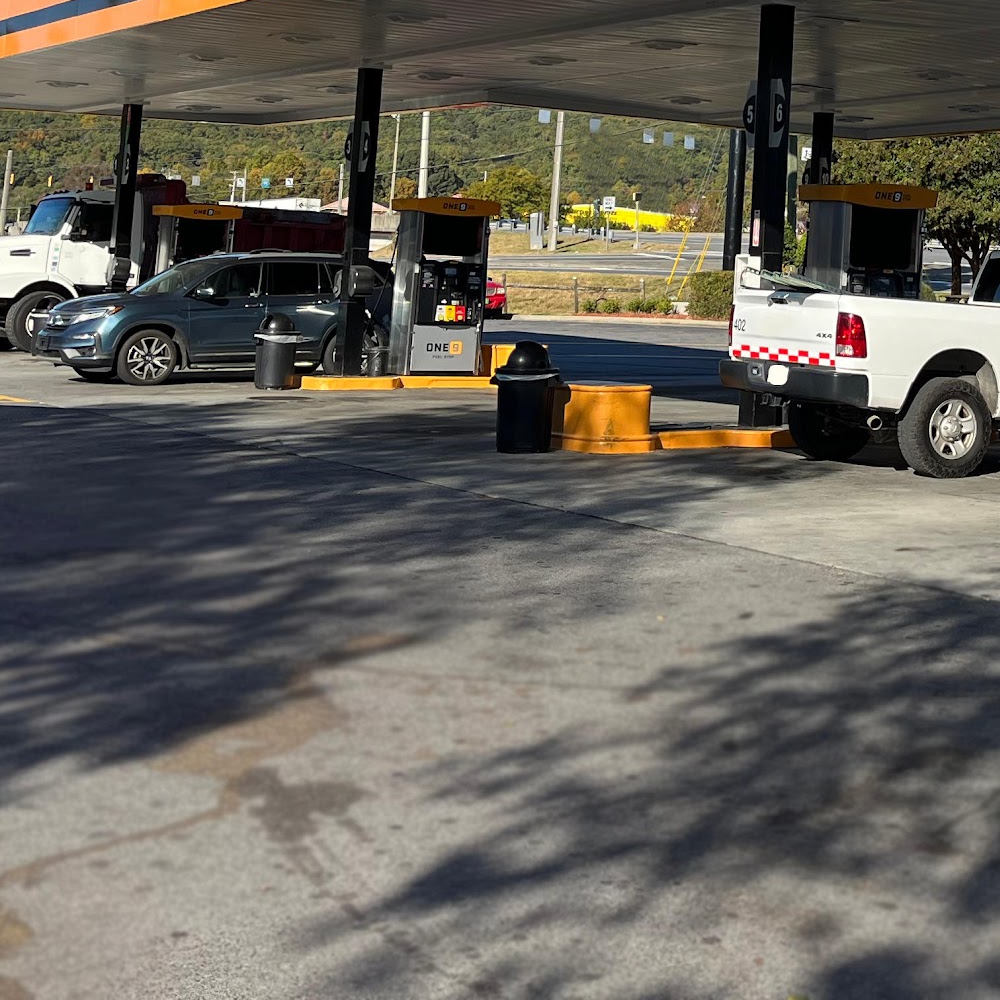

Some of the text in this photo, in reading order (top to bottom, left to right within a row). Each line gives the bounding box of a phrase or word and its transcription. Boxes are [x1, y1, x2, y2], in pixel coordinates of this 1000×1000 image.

[747, 105, 753, 124] 5
[776, 104, 783, 122] 6
[822, 173, 830, 185] 10
[734, 318, 746, 331] 402
